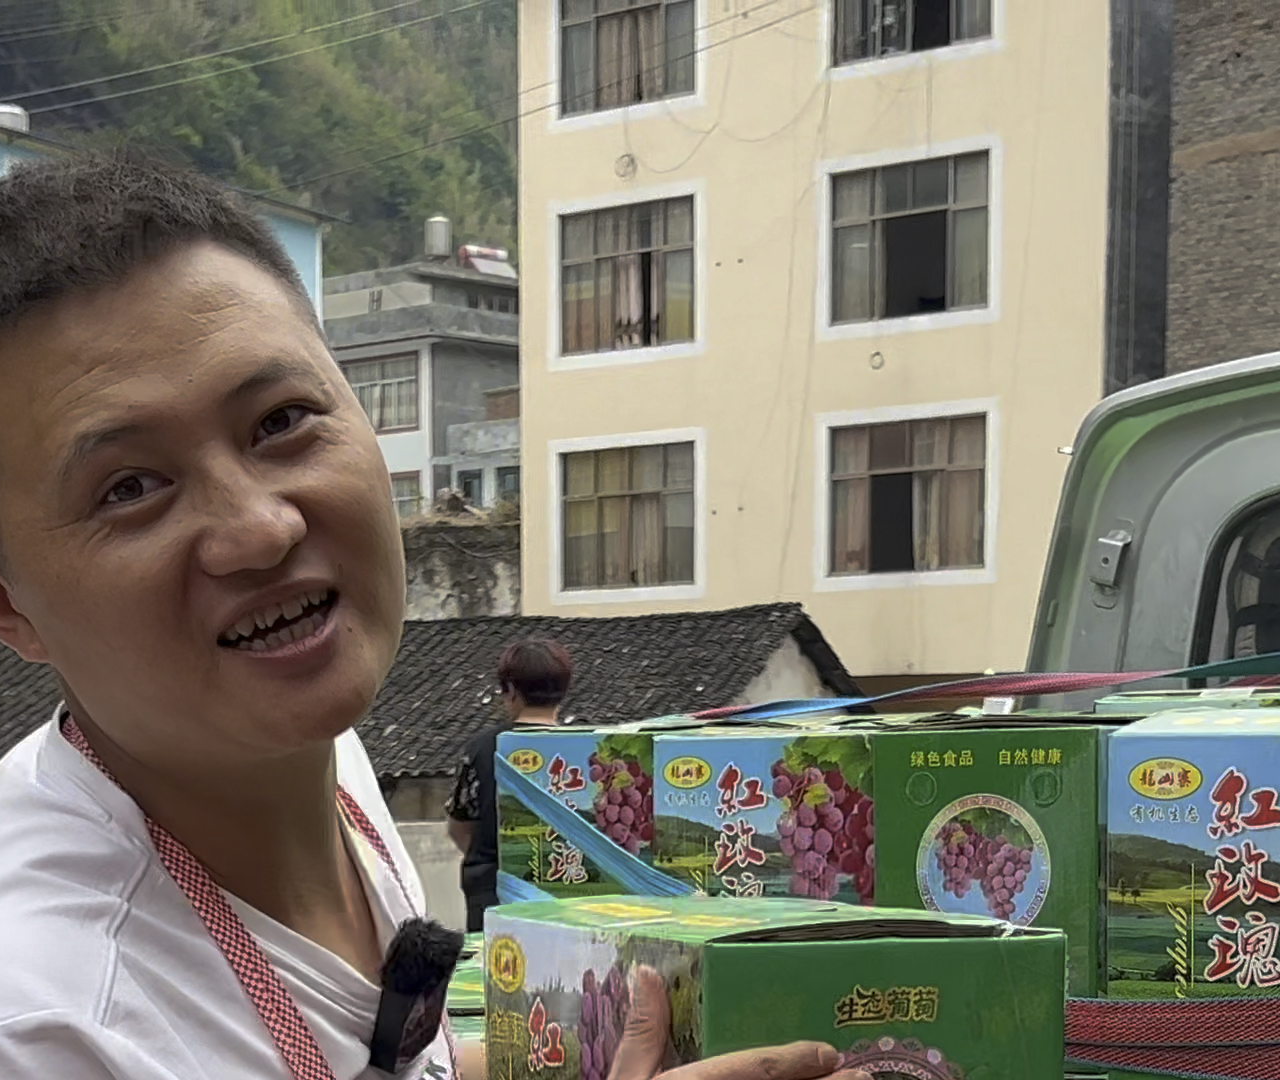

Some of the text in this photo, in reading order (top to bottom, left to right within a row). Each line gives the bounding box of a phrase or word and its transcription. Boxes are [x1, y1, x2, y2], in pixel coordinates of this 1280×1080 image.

[910, 748, 1062, 767] 绿色食品 自然健康
[834, 985, 938, 1028] 生态葡萄
